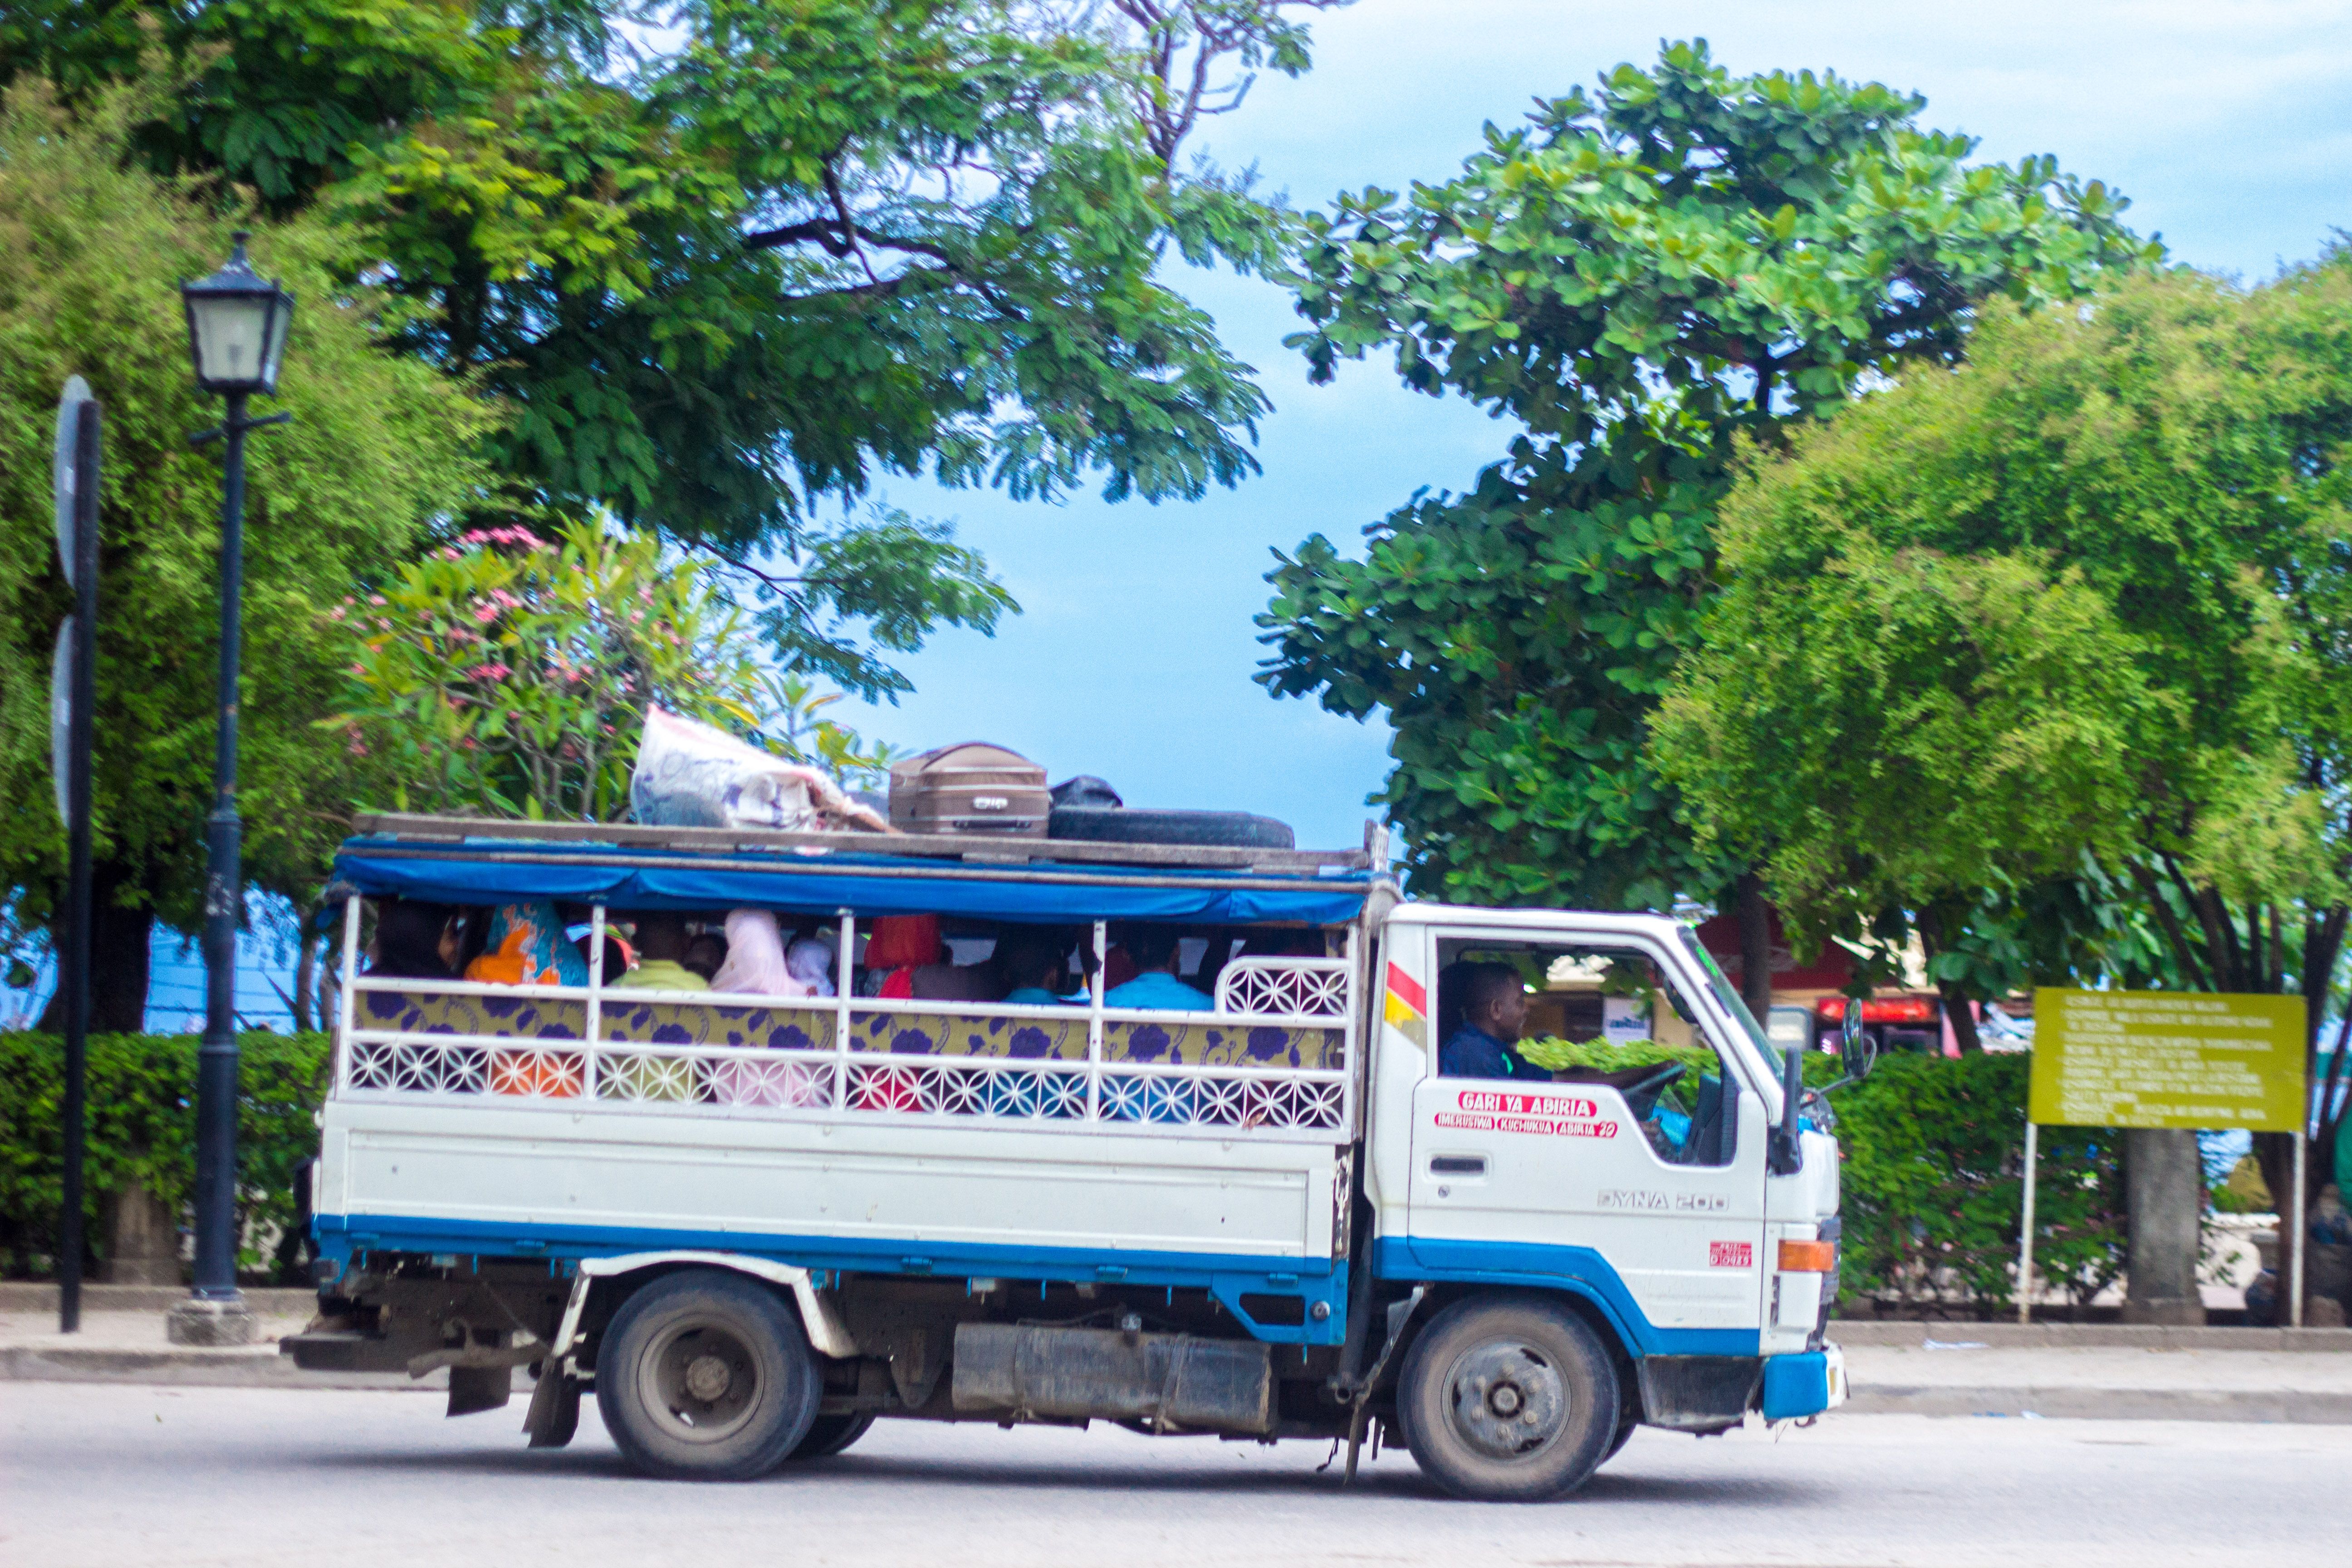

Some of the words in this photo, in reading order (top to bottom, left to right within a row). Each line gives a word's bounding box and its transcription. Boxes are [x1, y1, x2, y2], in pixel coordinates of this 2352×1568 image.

[1462, 1093, 1500, 1111] GARI
[1506, 1095, 1522, 1112] YA
[1531, 1097, 1590, 1117] ABIRIA
[1559, 1122, 1595, 1136] ABIRIA
[1600, 1122, 1616, 1137] 20
[1597, 1189, 1669, 1209] DYNA
[1676, 1192, 1730, 1210] 200
